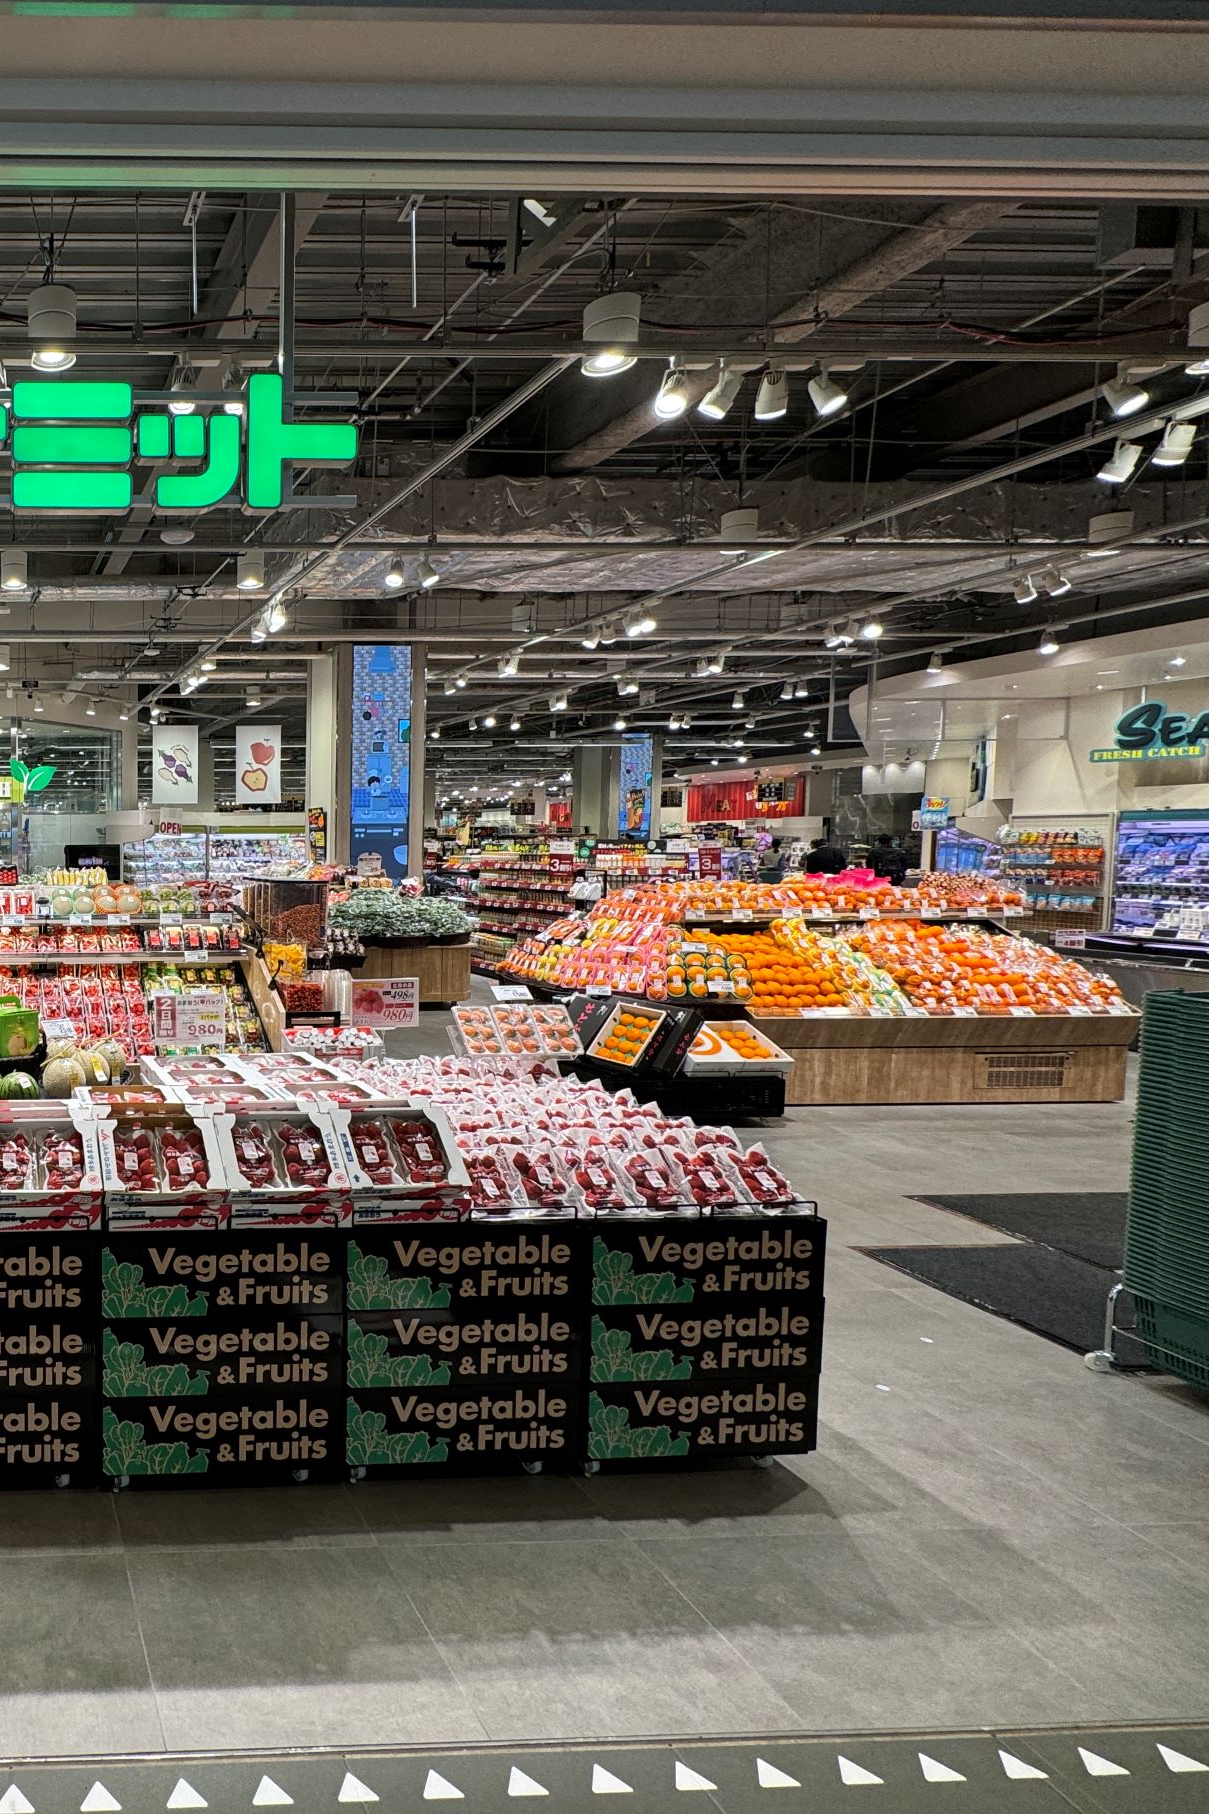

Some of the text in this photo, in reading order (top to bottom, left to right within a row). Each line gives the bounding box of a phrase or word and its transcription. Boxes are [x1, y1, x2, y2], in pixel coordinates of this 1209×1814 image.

[1094, 745, 1200, 761] FRESH CATCH
[160, 822, 182, 834] OPEN
[188, 1024, 223, 1035] 980円
[383, 1009, 413, 1020] 980円
[86, 1136, 95, 1172] 博多あまおう
[149, 1243, 330, 1283] Vegetable
[393, 1235, 571, 1275] Vegetable
[638, 1230, 812, 1269] Vegetable
[149, 1322, 330, 1362] Vegetable
[393, 1313, 570, 1353] Vegetable
[637, 1307, 809, 1347] Vegetable
[149, 1399, 328, 1440] Vegetable
[391, 1389, 567, 1429] Vegetable
[634, 1383, 806, 1423] Vegetable
